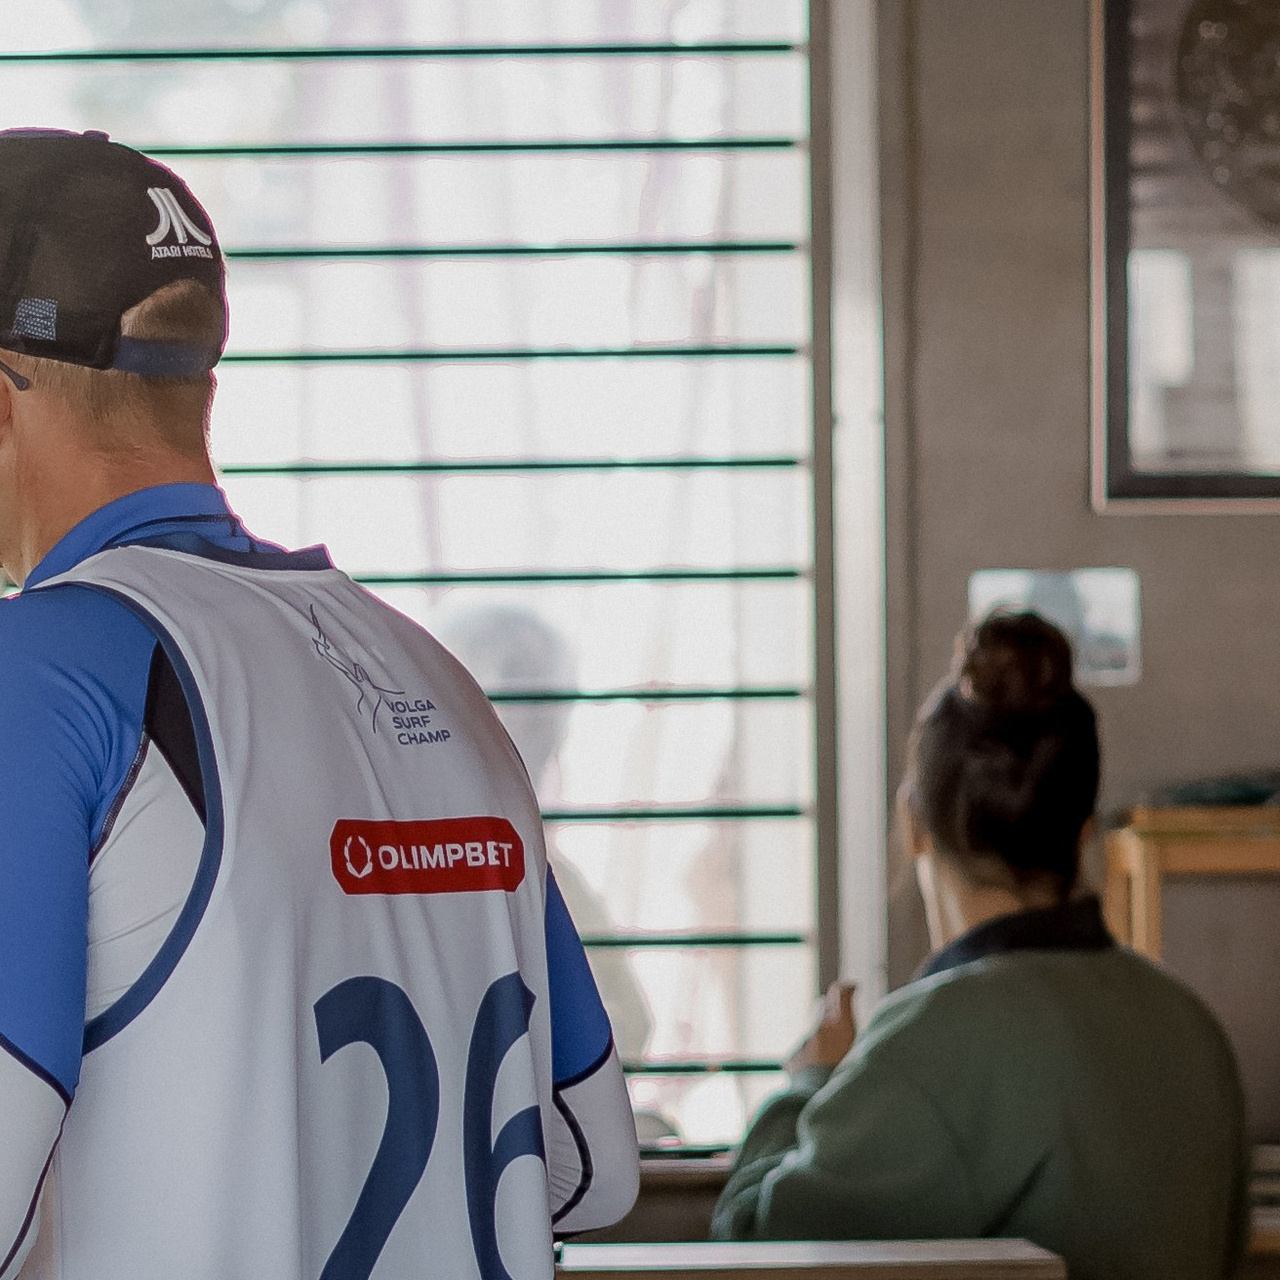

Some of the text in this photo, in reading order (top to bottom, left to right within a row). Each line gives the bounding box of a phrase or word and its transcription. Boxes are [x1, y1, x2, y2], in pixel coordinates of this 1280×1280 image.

[385, 698, 437, 714] VOLGA
[392, 715, 431, 730] SURF
[397, 730, 452, 746] CHAMP
[378, 841, 513, 870] OLIMPBET
